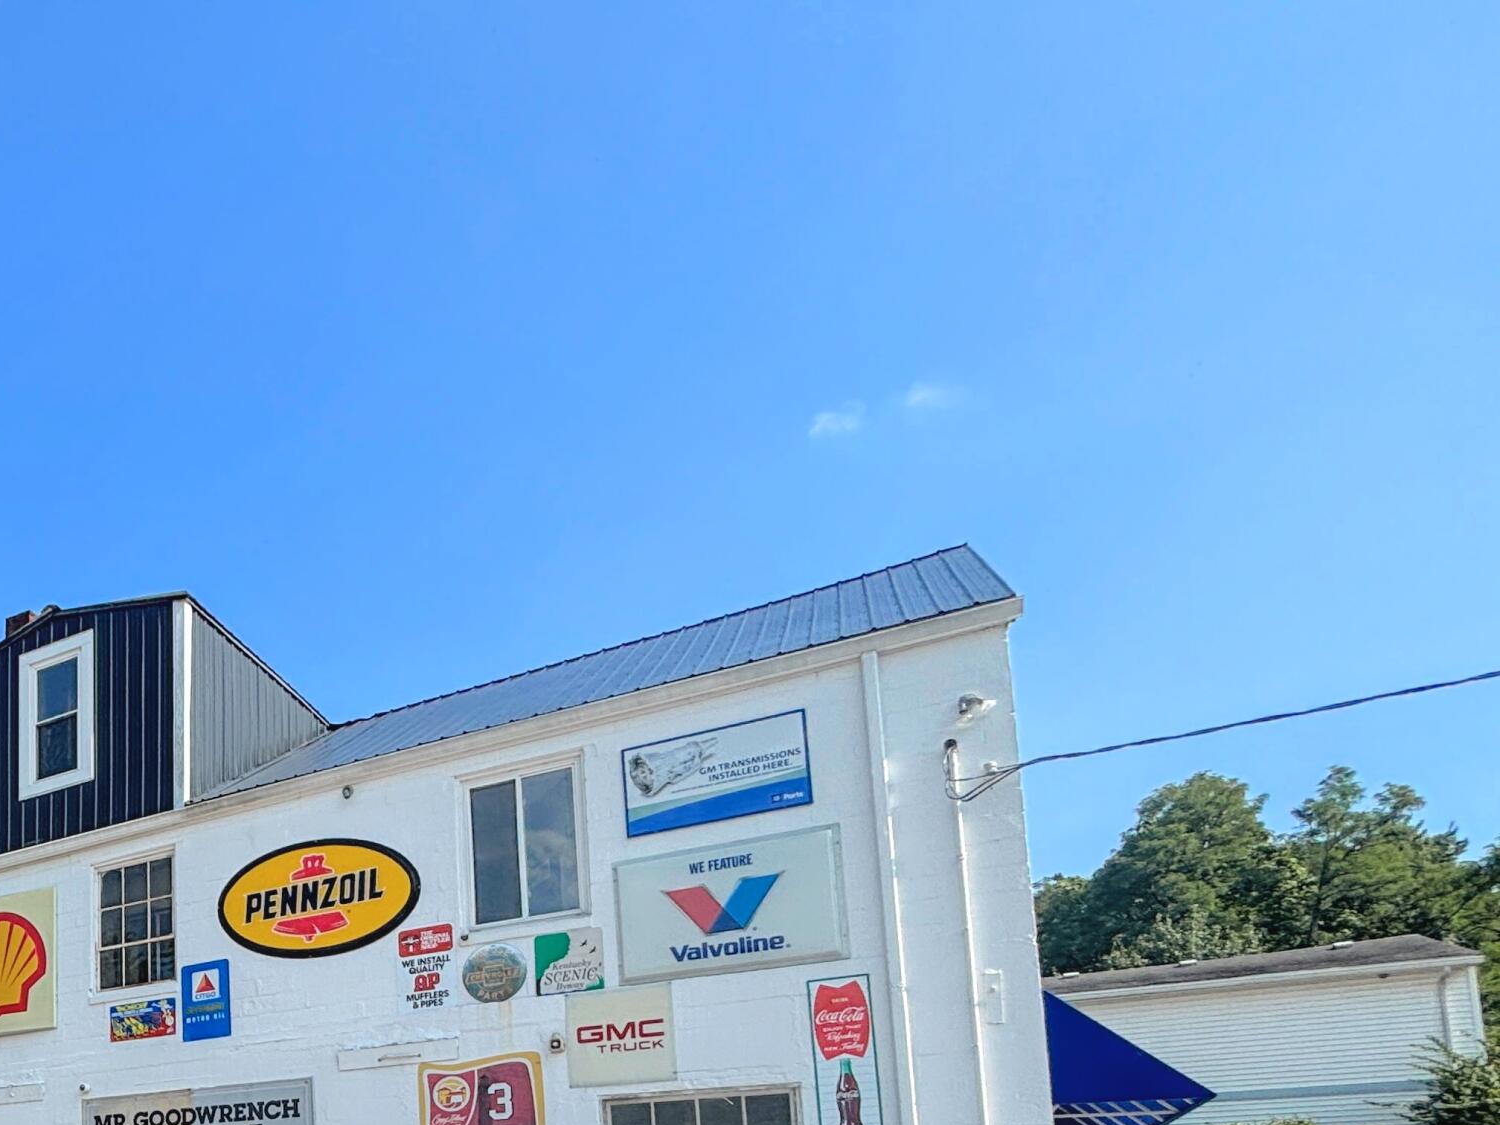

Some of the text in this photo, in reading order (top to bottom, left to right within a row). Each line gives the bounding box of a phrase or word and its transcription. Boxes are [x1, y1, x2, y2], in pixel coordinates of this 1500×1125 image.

[699, 747, 802, 775] GM TRANSMISSIONS
[708, 765, 761, 782] INSTALLED
[689, 853, 754, 874] WE FEATURE
[244, 867, 384, 924] PENNZOIL
[669, 935, 786, 962] Valvoline
[401, 954, 451, 968] WE INSTALL
[553, 959, 591, 971] Kentucky
[409, 963, 445, 975] QUALITY
[544, 967, 597, 985] SCENIC
[195, 991, 216, 1000] CITGO
[406, 990, 450, 1002] MUFFLERS
[412, 999, 444, 1009] & PIPES
[186, 1011, 225, 1024] MOTOR OIL
[577, 1018, 665, 1044] GMC
[596, 1040, 664, 1054] TRUCK
[487, 1082, 513, 1120] 3
